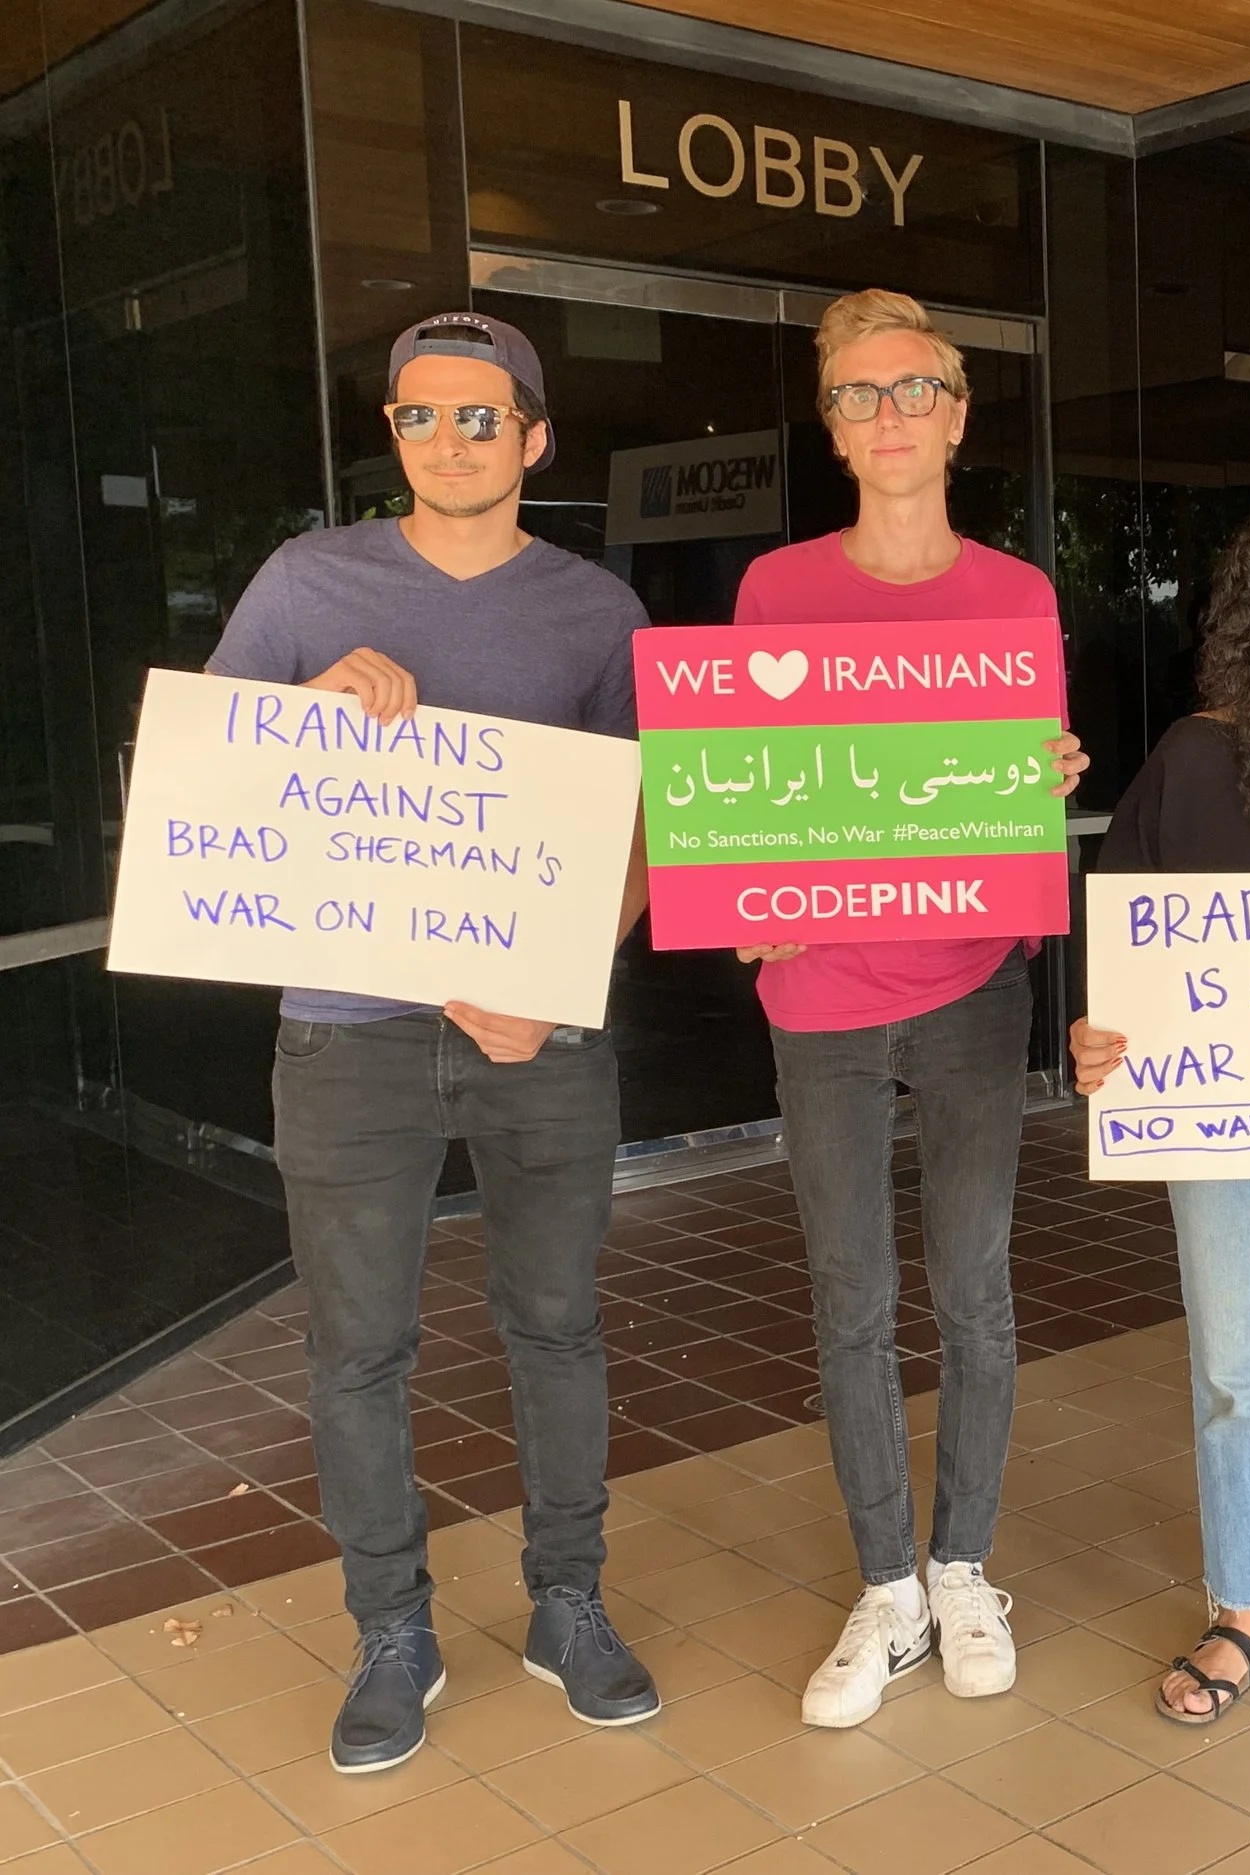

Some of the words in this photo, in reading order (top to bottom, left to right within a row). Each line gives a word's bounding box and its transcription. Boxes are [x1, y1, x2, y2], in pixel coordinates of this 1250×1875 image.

[619, 100, 924, 226] LOBBY
[656, 659, 736, 696] WE
[822, 651, 1037, 693] IRANIANS
[226, 692, 505, 773] IRANIANS
[666, 743, 823, 807] ایرانیان
[849, 744, 880, 800] با
[899, 753, 1042, 806] دوستی
[279, 772, 509, 833] AGAINST
[167, 819, 289, 863] BRAD
[669, 830, 702, 849] No
[707, 828, 803, 850] Sanctions,
[808, 826, 840, 845] No
[840, 824, 885, 844] War
[892, 819, 1045, 842] #PeaceWithIran
[183, 889, 298, 932] WAR
[315, 899, 376, 933] ON
[411, 907, 518, 950] IRAN
[736, 879, 990, 922] CODEPINK
[1184, 967, 1229, 1013] IS
[1124, 1042, 1246, 1095] WAR
[1109, 1115, 1176, 1144] NO
